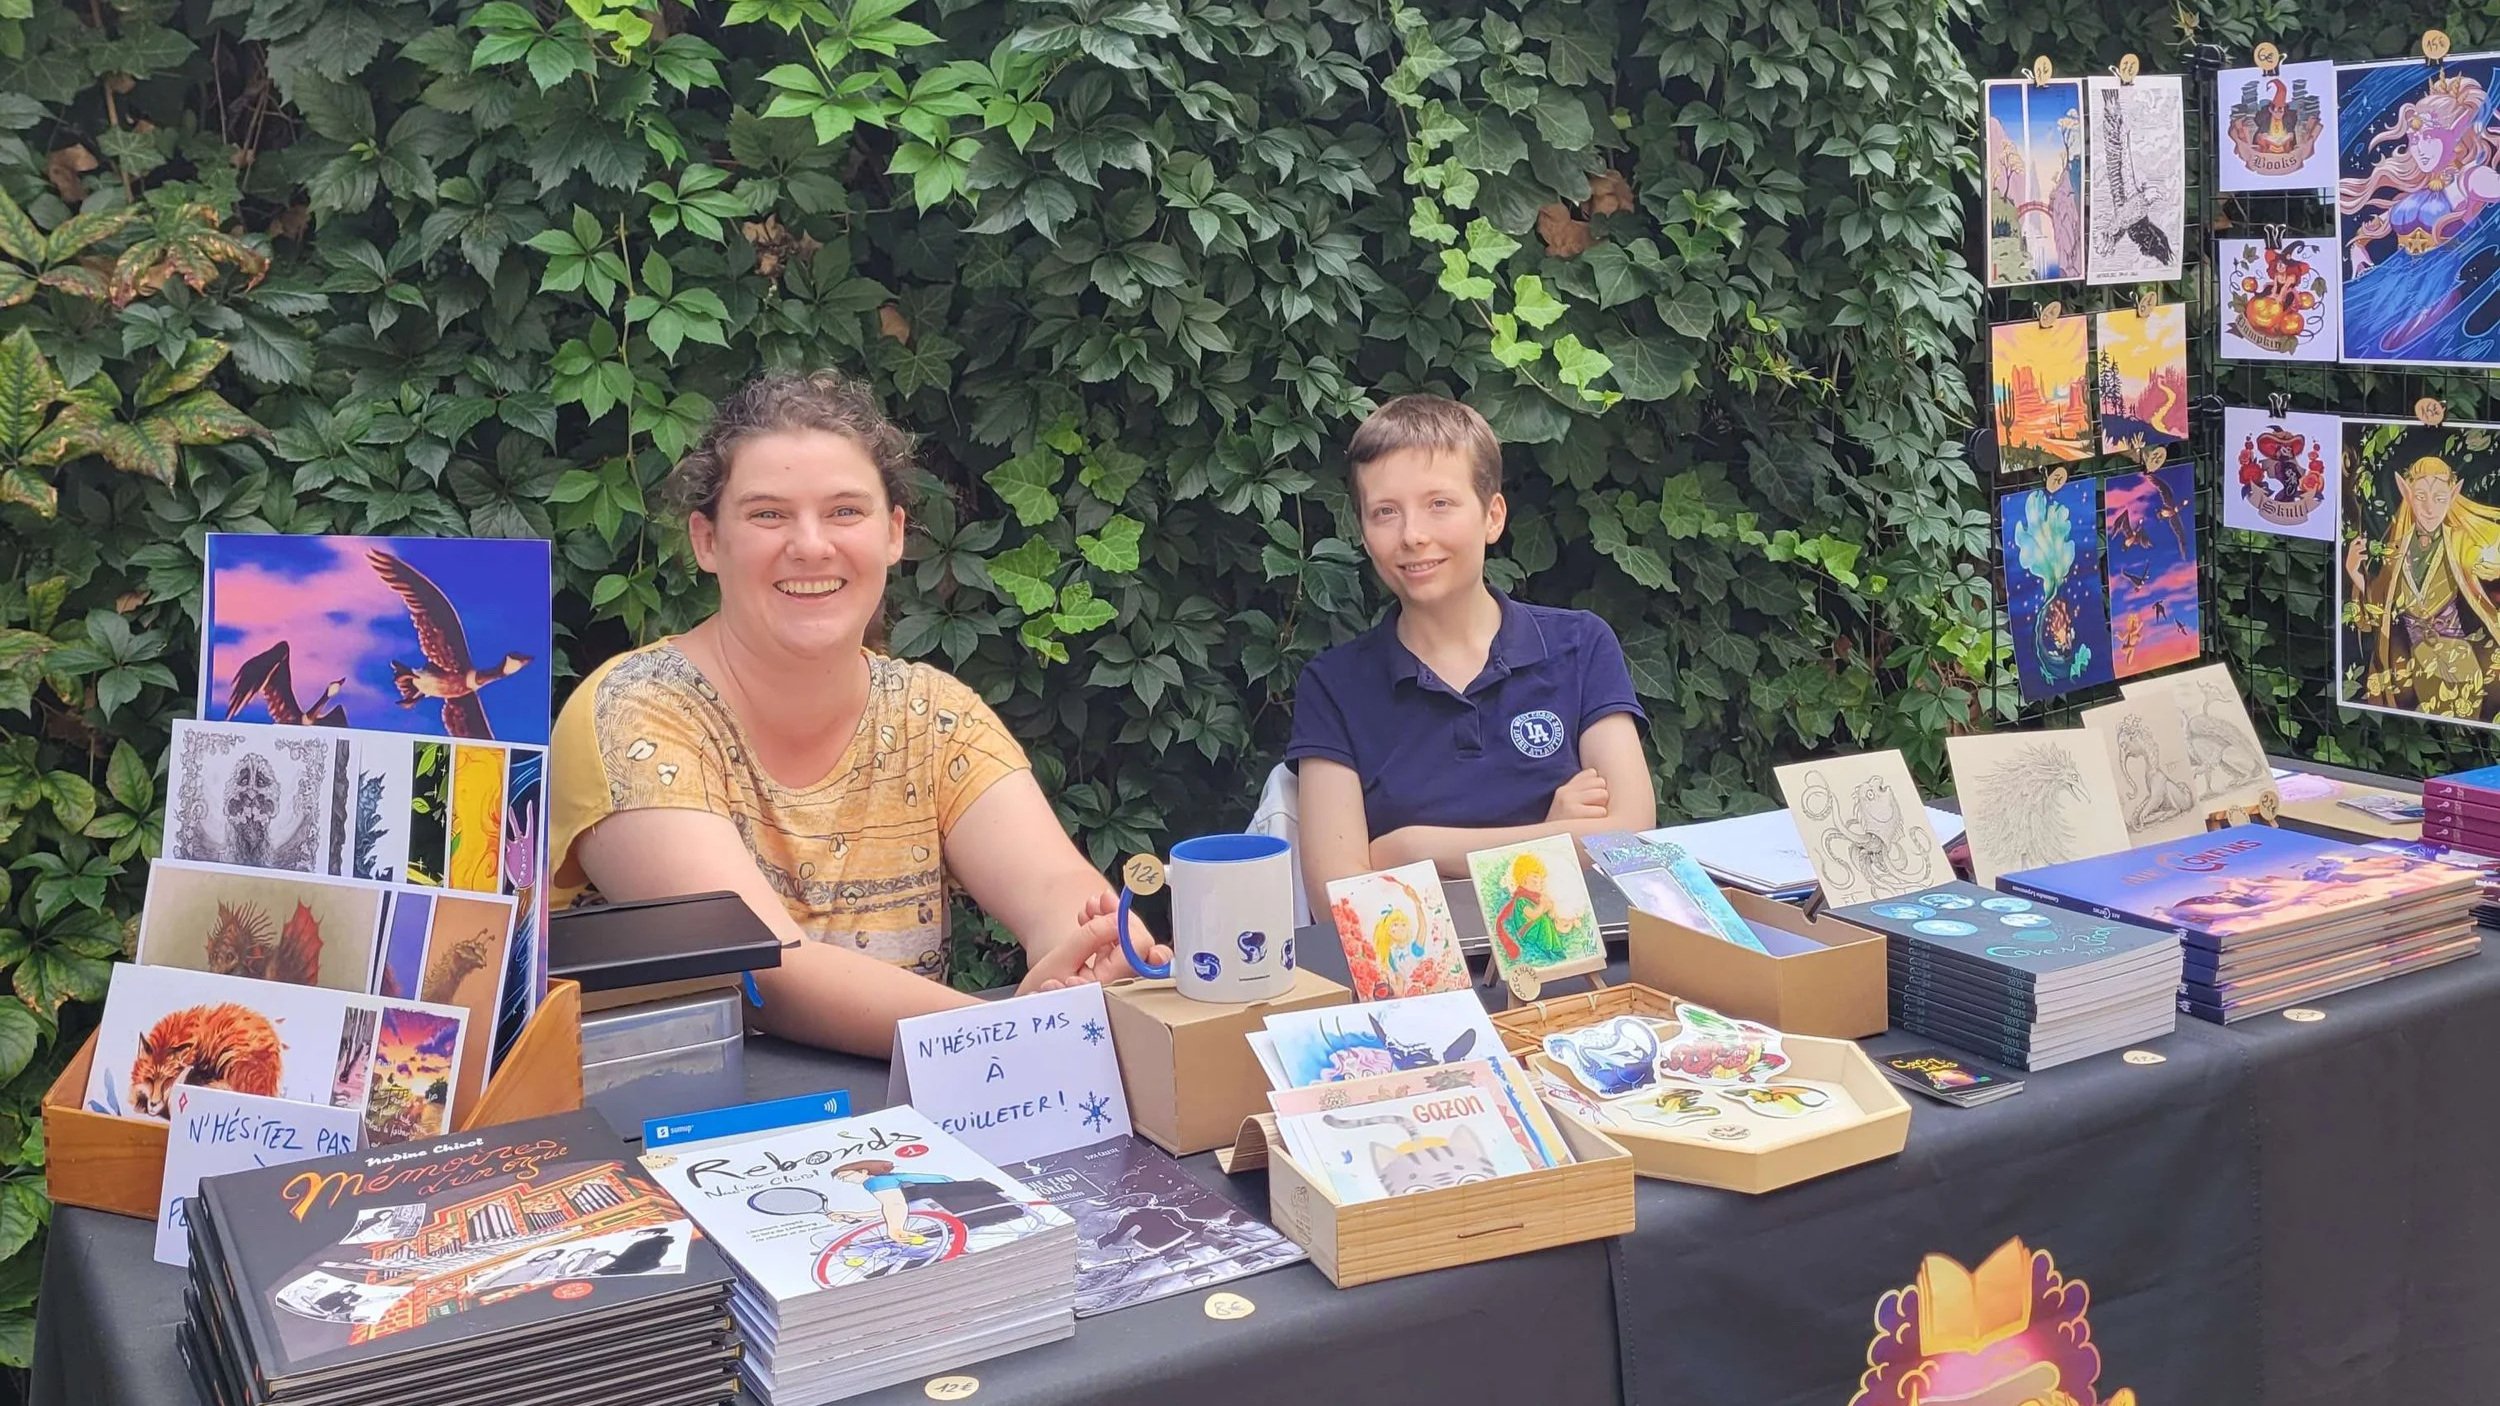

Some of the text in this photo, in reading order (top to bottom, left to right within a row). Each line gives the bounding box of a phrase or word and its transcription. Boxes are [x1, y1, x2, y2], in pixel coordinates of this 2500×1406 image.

[2252, 154, 2298, 170] Books
[2262, 500, 2304, 519] Skull
[1524, 721, 1550, 745] LA
[1032, 1012, 1071, 1034] PAS
[986, 1056, 1005, 1083] À
[935, 1095, 1052, 1135] EUiLLETER
[686, 1127, 923, 1189] Rebonds
[280, 1139, 558, 1223] Mémoires
[934, 1382, 973, 1394] 12€
